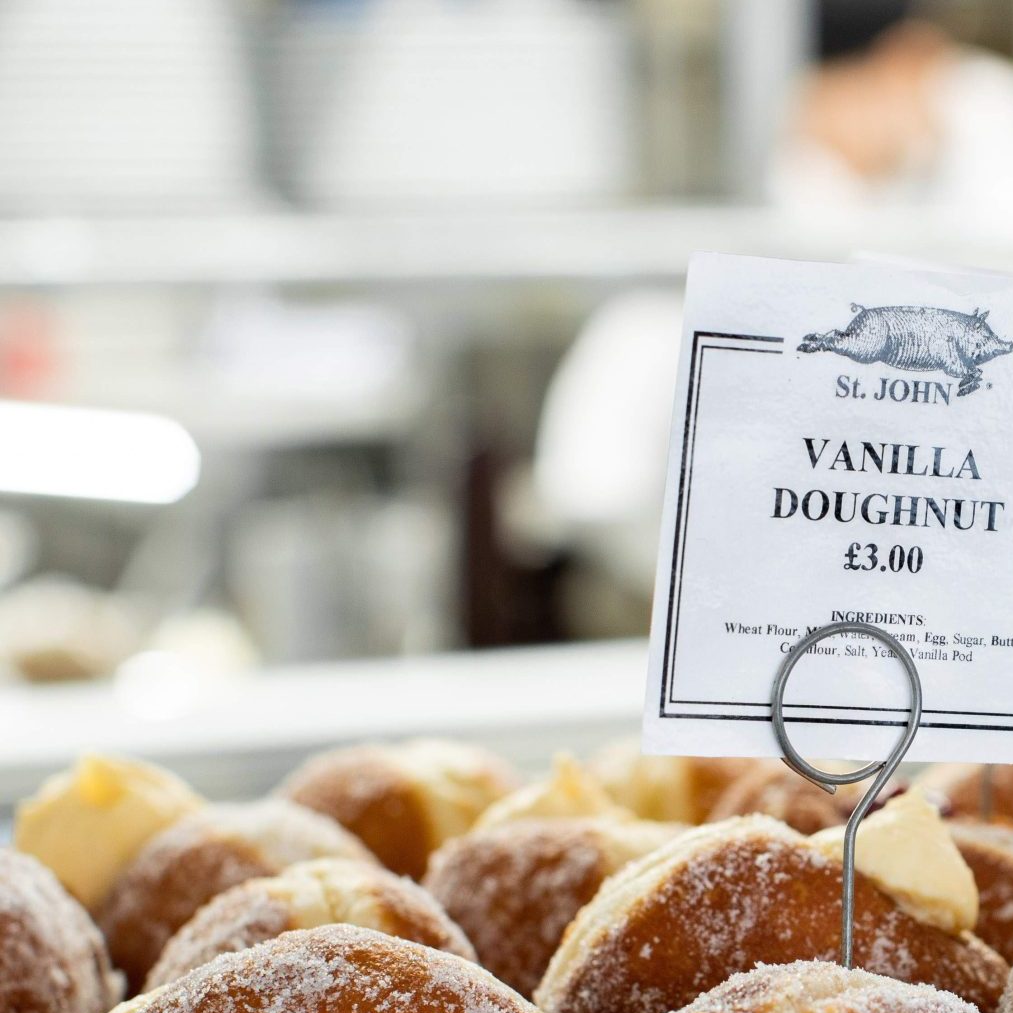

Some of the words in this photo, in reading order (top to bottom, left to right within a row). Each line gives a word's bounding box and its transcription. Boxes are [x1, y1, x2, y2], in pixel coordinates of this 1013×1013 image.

[835, 374, 866, 400] St.
[873, 377, 953, 406] JOHN
[802, 437, 982, 480] VANILLA
[770, 487, 1005, 532] DOUGHNUT
[843, 542, 924, 574] £3.00
[831, 610, 927, 626] INGREDIENTS:
[725, 622, 762, 635] Wheat
[766, 624, 801, 639] Flour,
[886, 630, 920, 644] eam,
[953, 633, 987, 648] Sugar,
[780, 641, 840, 658] Colour,
[844, 645, 868, 658] Salt,
[909, 648, 948, 661] Vanilla
[952, 650, 973, 662] Pod
